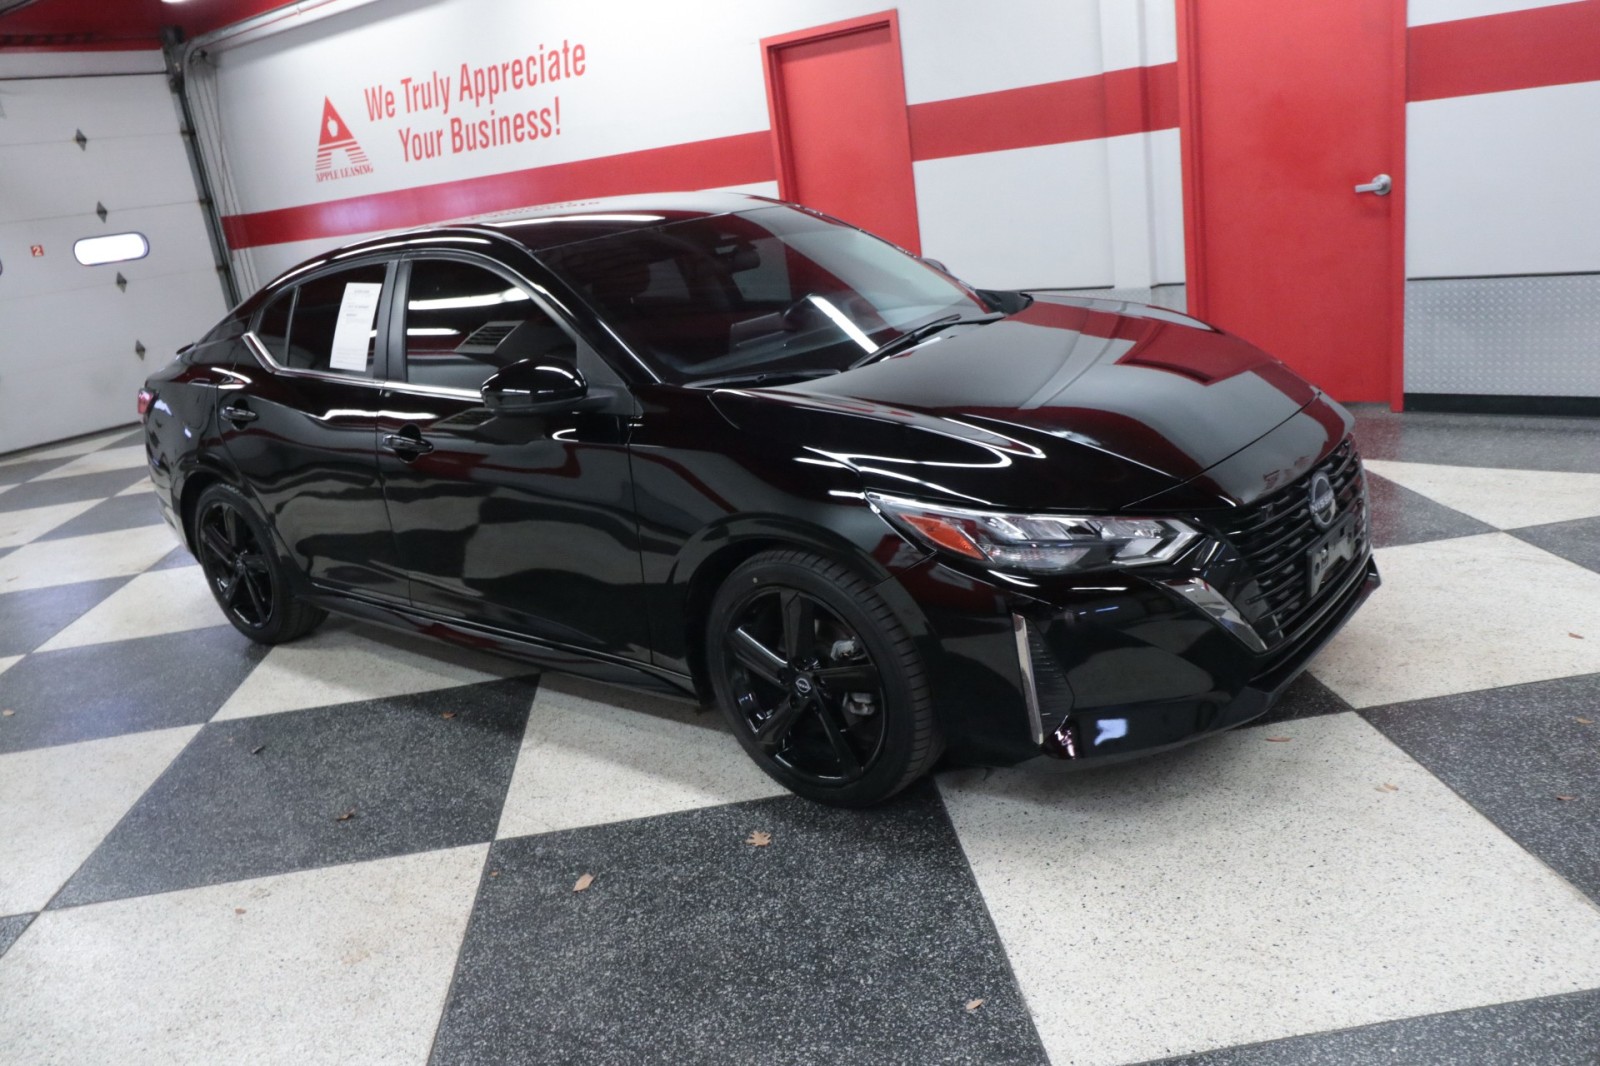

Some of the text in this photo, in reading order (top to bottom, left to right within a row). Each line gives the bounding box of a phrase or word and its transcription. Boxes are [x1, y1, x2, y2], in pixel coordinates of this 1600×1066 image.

[364, 39, 586, 122] We Truly Appreciate
[398, 96, 561, 162] Your Business!
[315, 164, 374, 183] APPLE LEASING
[33, 246, 42, 256] 2
